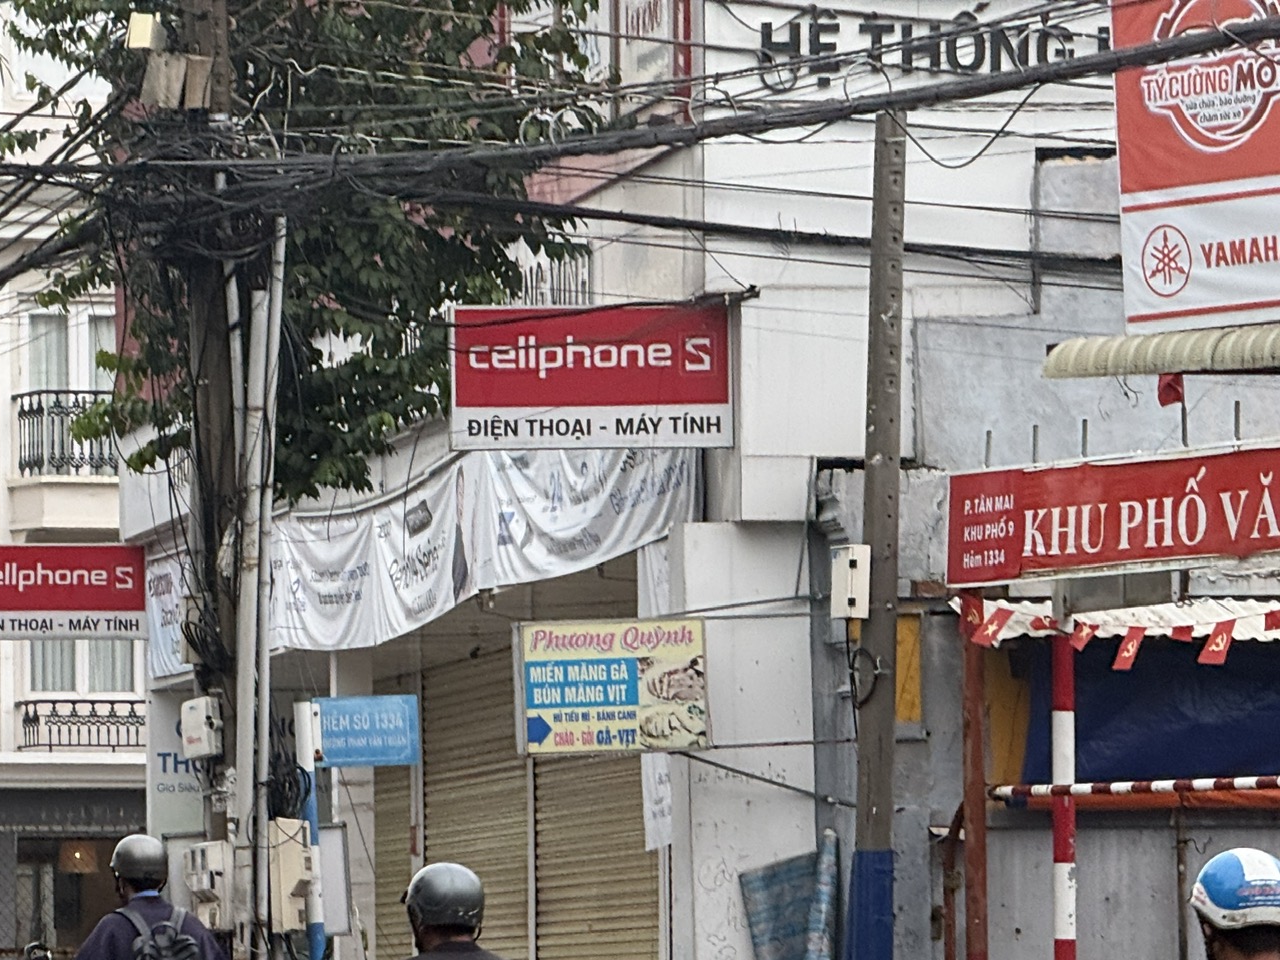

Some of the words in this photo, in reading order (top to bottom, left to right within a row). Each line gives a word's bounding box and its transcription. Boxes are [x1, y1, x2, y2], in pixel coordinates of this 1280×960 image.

[760, 9, 840, 89] HỆ
[859, 3, 1075, 74] THỐNG
[1169, 67, 1230, 99] CƯỜNG
[467, 415, 518, 441] ĐIỆN
[525, 417, 592, 440] THOẠI
[615, 413, 663, 436] MÁY
[669, 412, 722, 435] TÍNH
[974, 493, 994, 515] TÂN
[995, 493, 1014, 512] MAI
[1022, 503, 1108, 557] KHU
[1117, 466, 1207, 550] PHỐ
[964, 524, 984, 542] KHU
[985, 515, 1006, 539] PHỐ
[1008, 520, 1015, 537] 9
[984, 548, 1005, 566] 1334
[9, 618, 53, 634] THOẠI
[69, 615, 100, 631] MÁY
[104, 616, 139, 631] TÍNH
[531, 629, 615, 651] Phương
[622, 625, 694, 651] Quỳnh
[568, 661, 607, 682] MĂNG
[610, 660, 628, 681] GÀ
[533, 684, 562, 704] BÚN
[565, 683, 604, 704] MĂNG
[607, 684, 627, 705] VỊT
[157, 783, 176, 793] Gia
